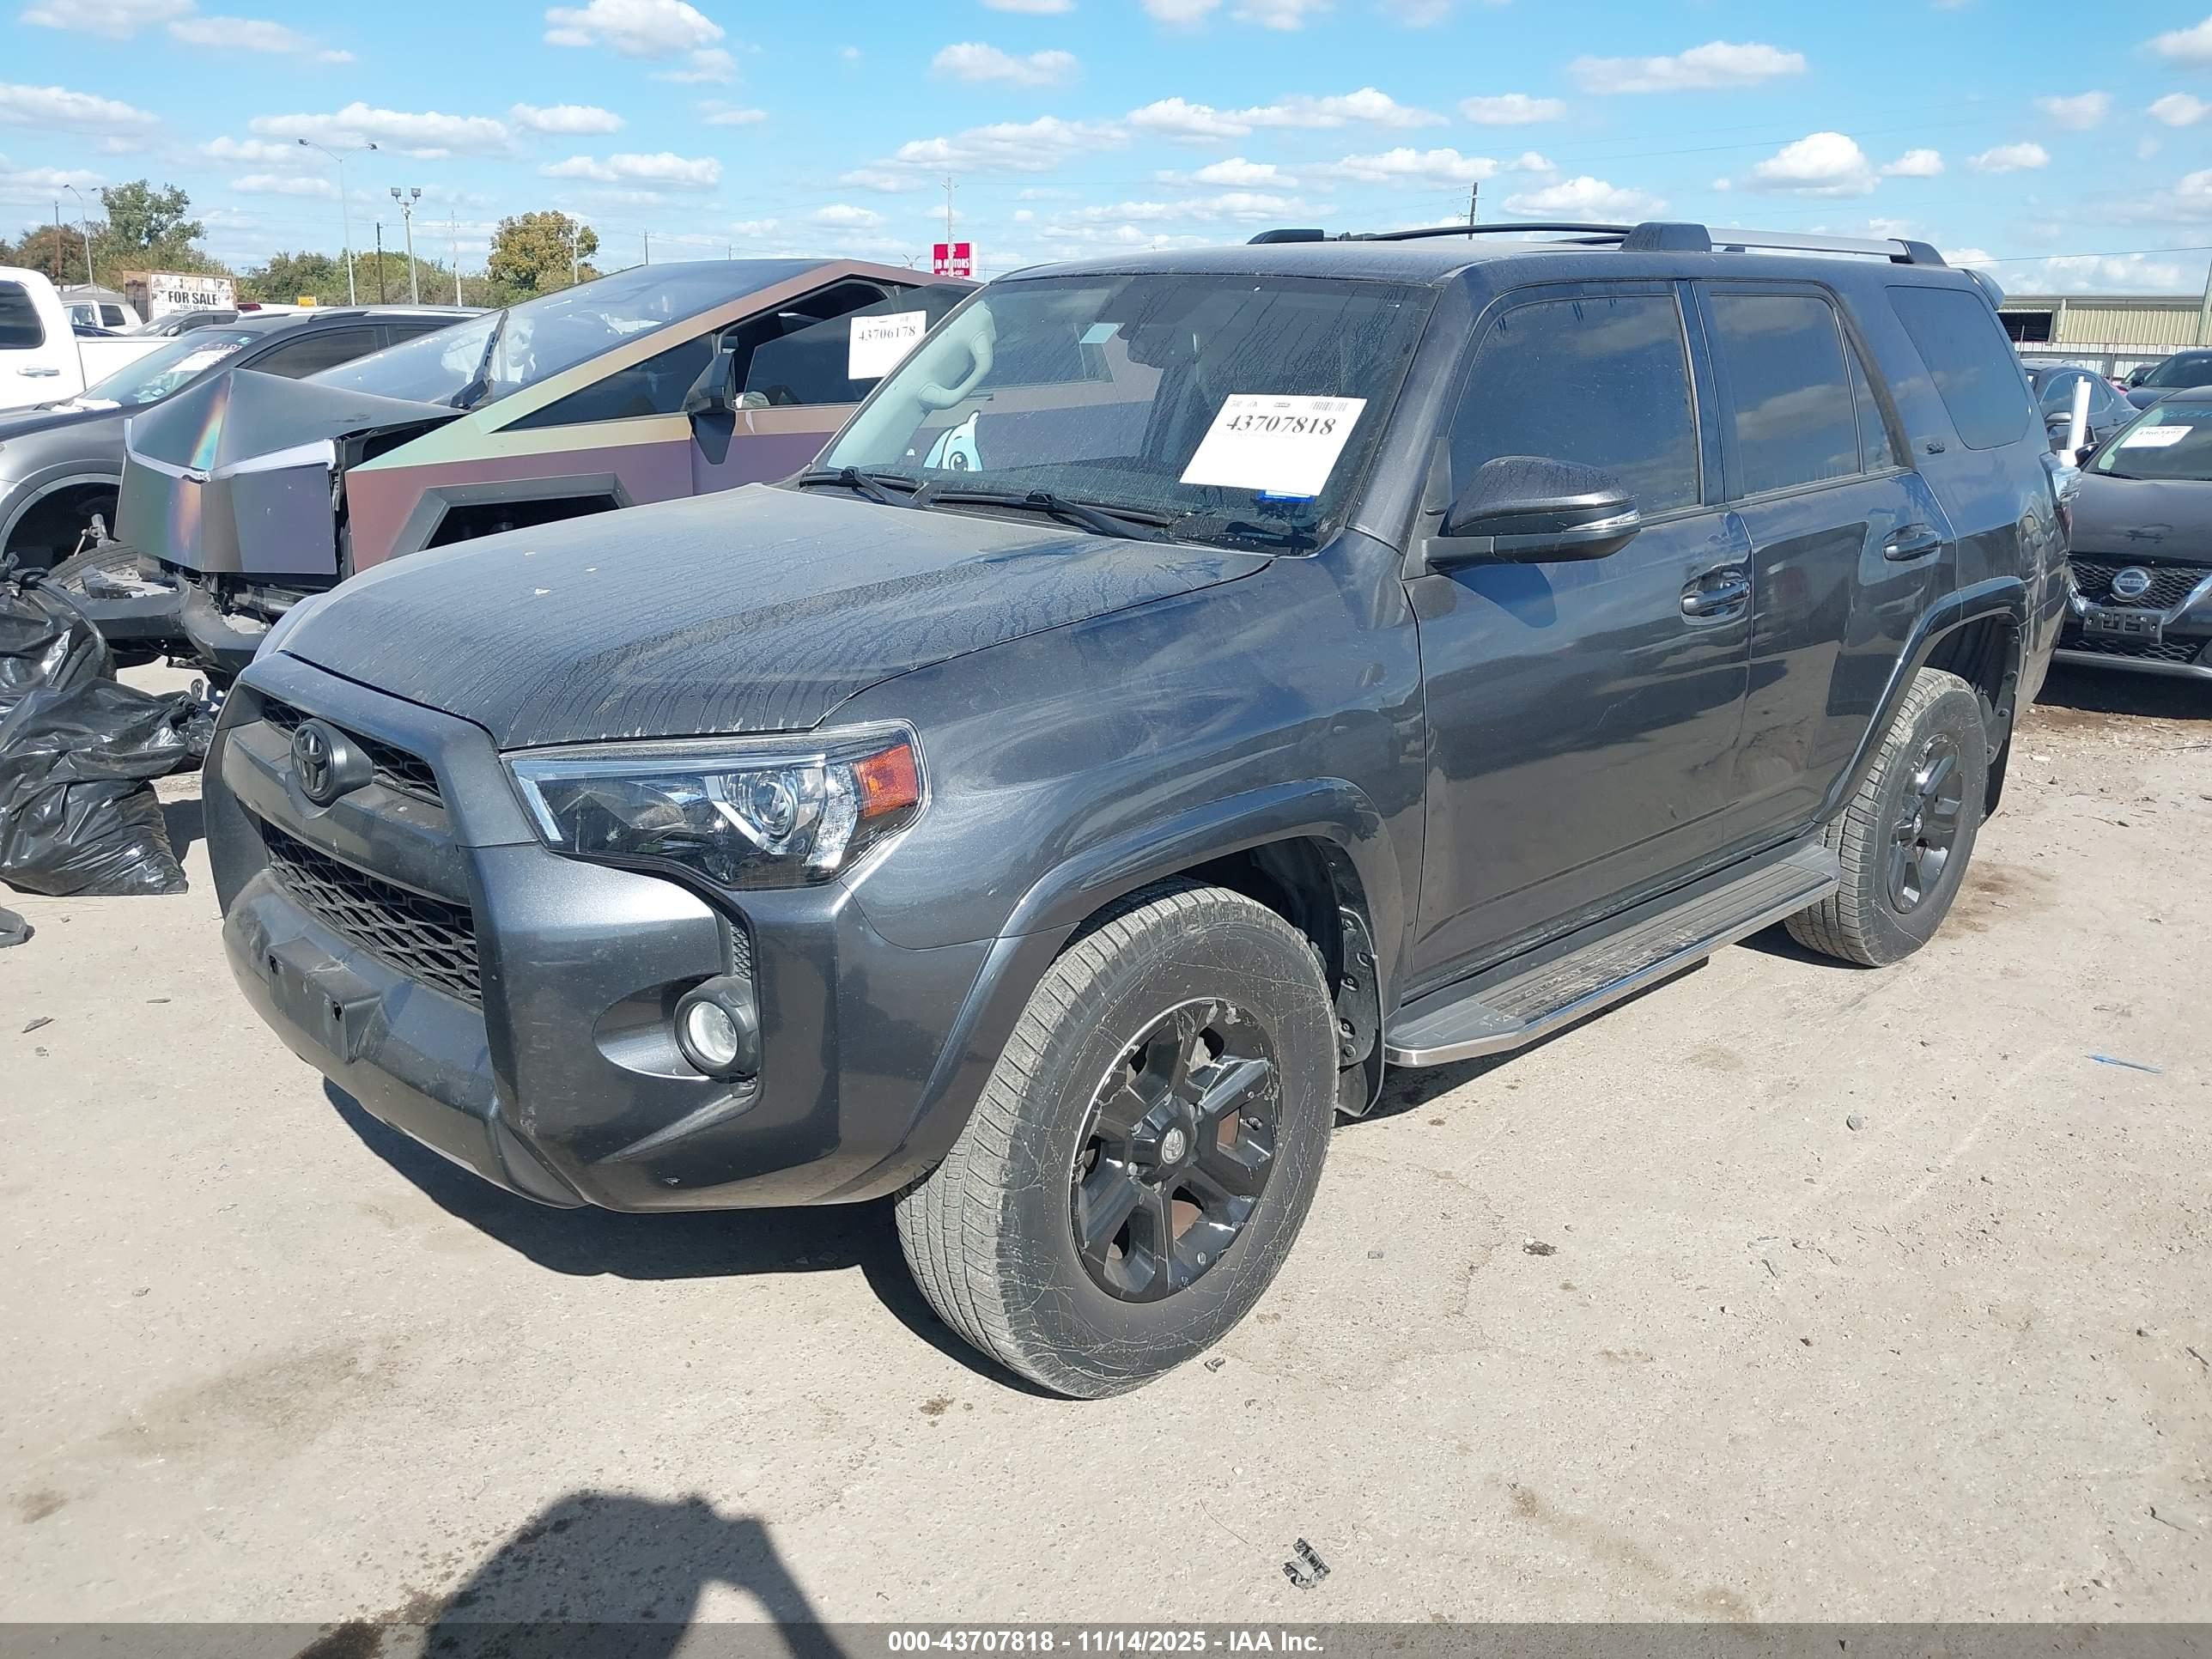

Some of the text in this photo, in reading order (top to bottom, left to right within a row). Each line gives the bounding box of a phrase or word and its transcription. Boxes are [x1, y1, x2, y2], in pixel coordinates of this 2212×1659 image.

[168, 290, 218, 306] FOR SALE
[858, 325, 916, 342] 43706178
[1226, 414, 1336, 436] 43707818
